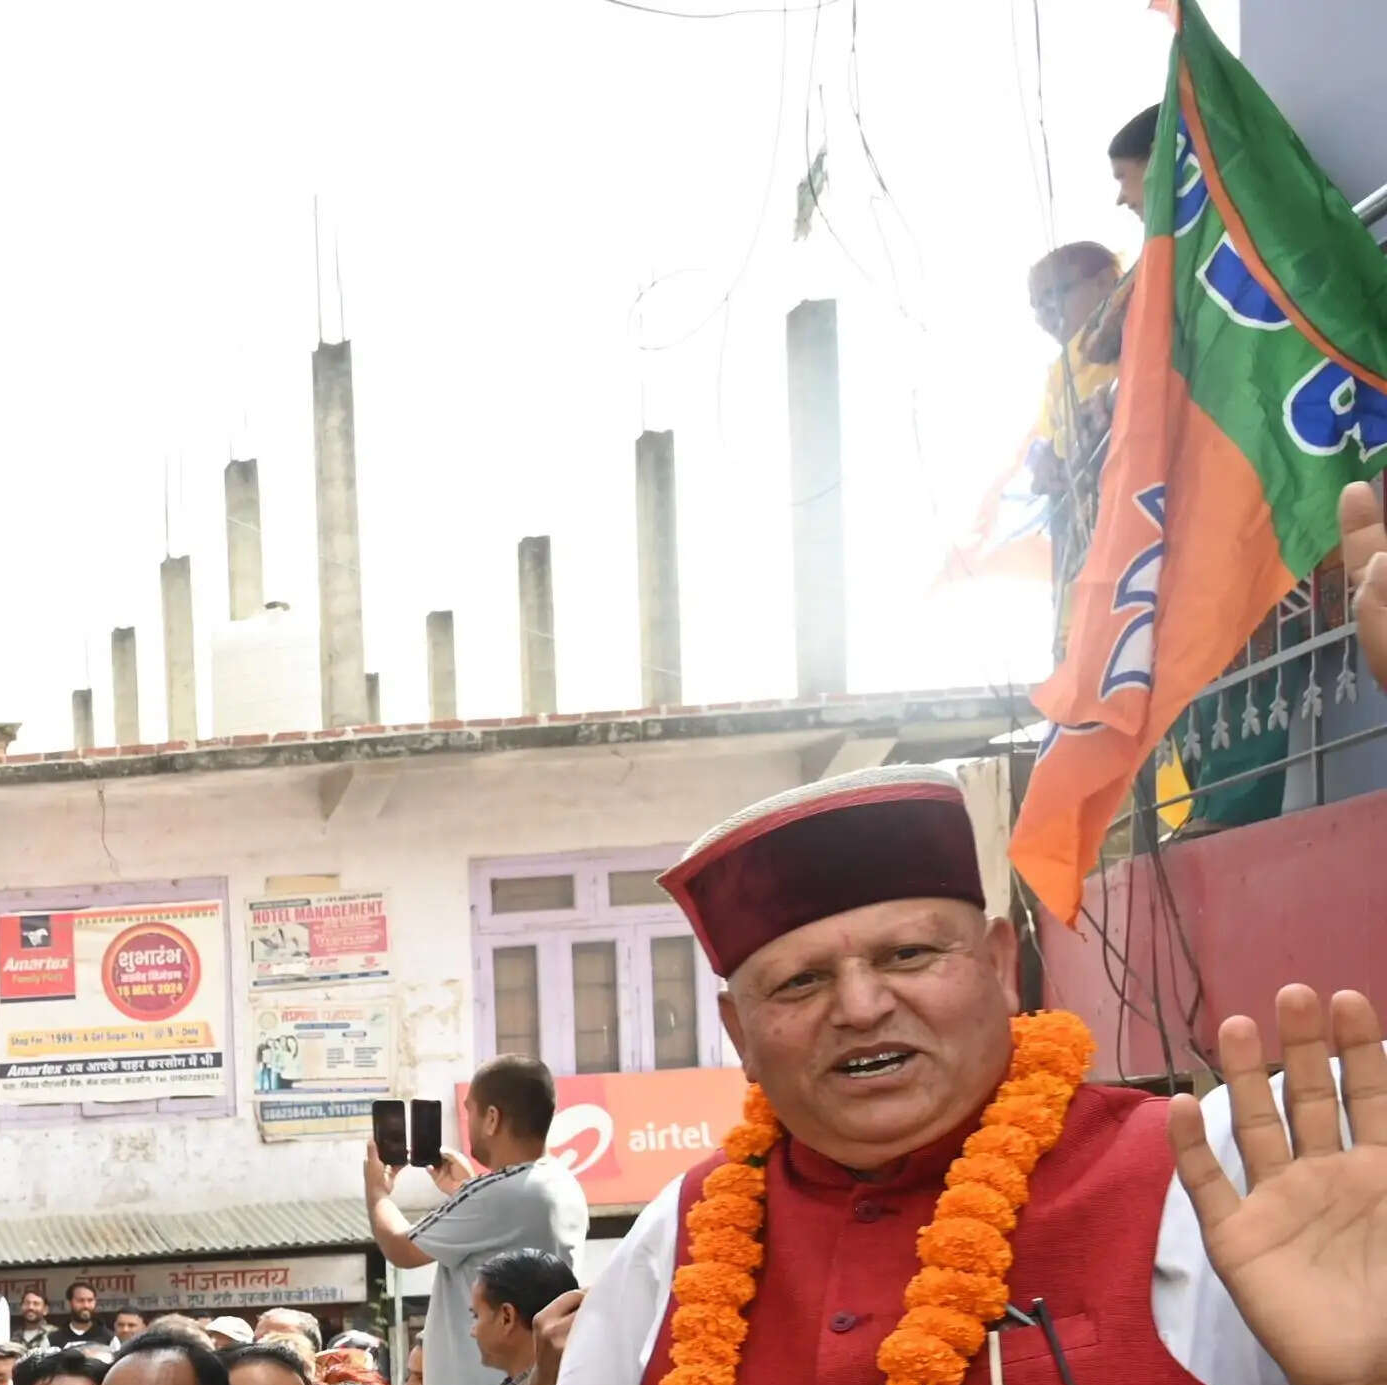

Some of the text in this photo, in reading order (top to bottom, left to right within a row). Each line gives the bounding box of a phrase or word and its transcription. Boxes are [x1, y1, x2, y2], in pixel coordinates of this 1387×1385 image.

[253, 909, 292, 924] HOTEL
[295, 901, 383, 921] MANAGEMENT
[3, 957, 69, 972] Amartex
[7, 1063, 63, 1077] Amartex
[86, 1057, 118, 1073] आपके
[200, 1053, 214, 1066] भी
[628, 1121, 714, 1152] airtel
[168, 1264, 290, 1291] भोजनालय
